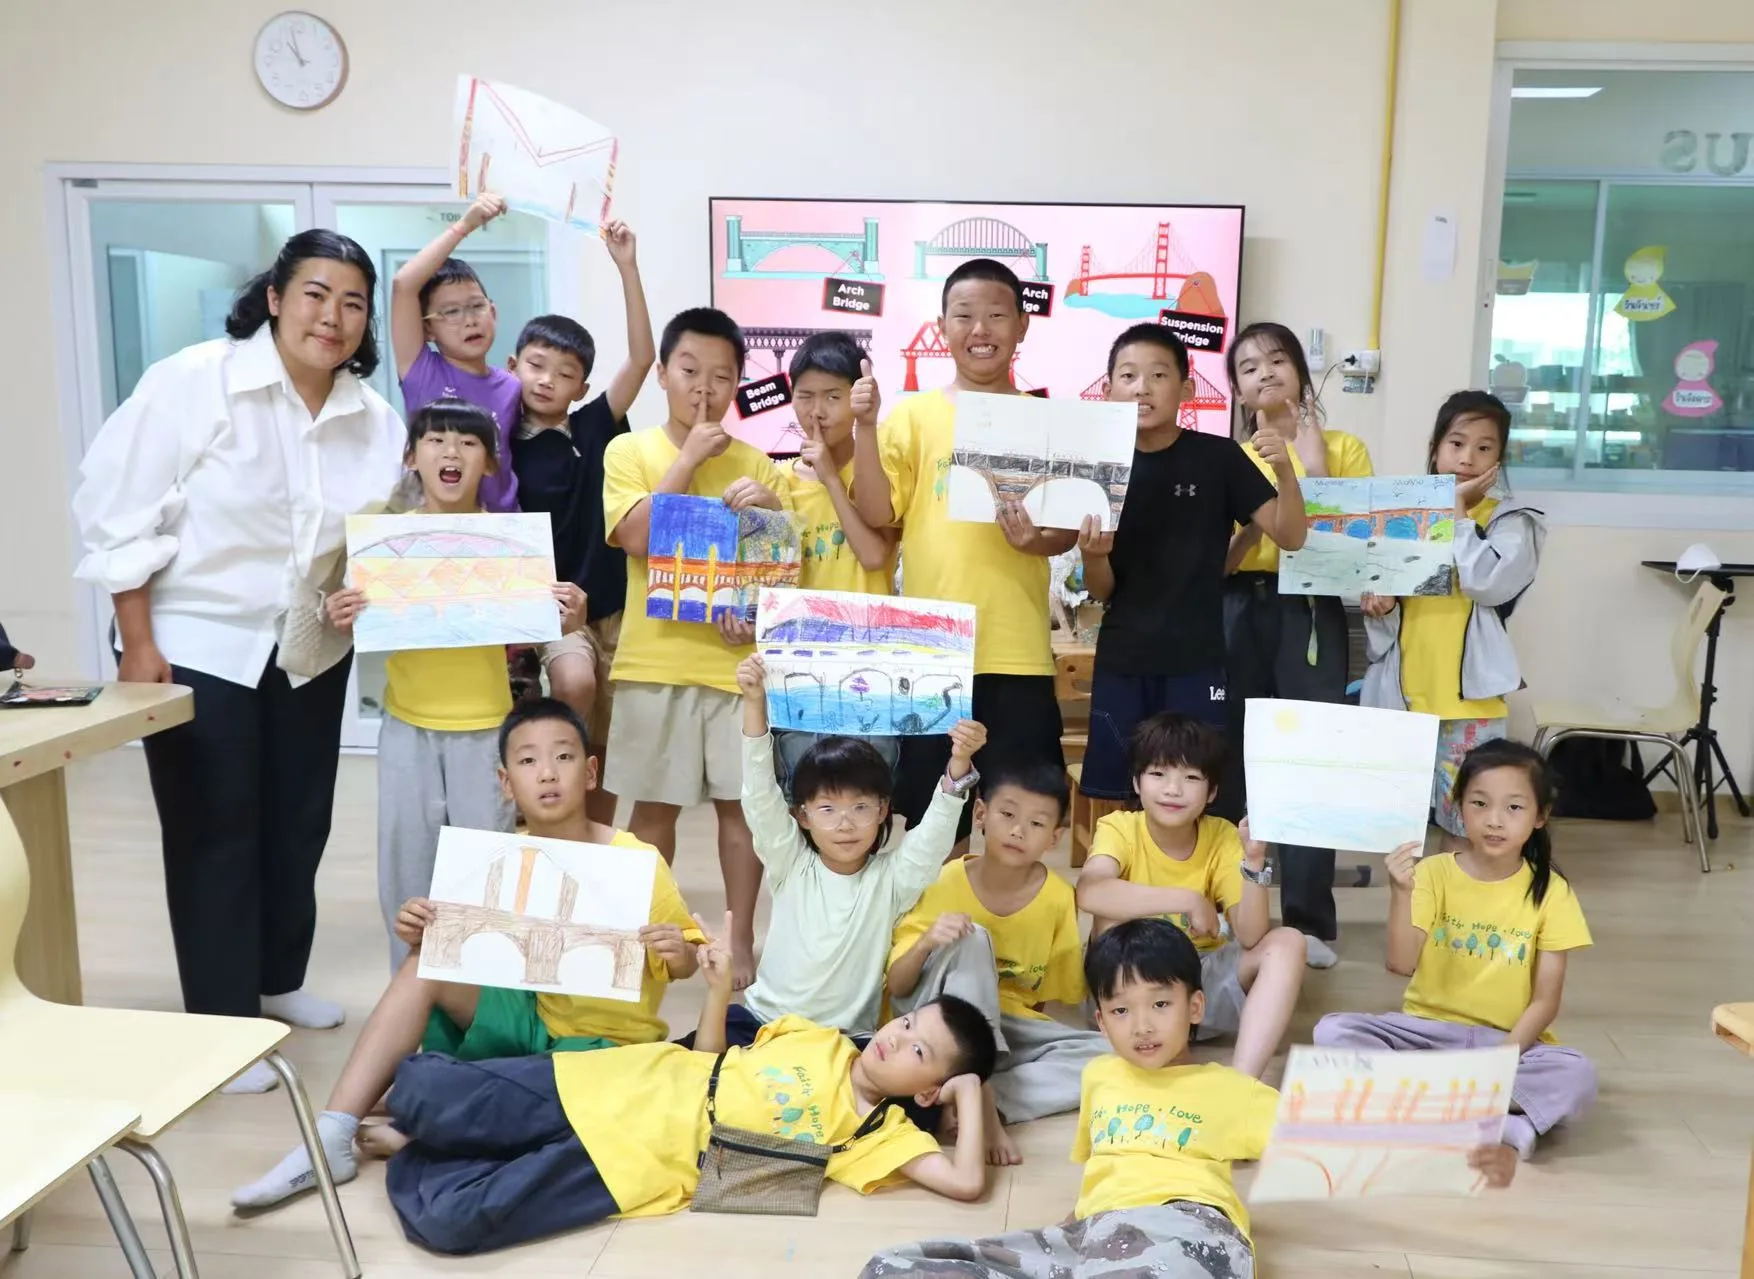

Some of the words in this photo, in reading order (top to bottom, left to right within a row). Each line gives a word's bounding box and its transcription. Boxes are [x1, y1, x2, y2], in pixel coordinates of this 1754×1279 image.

[838, 284, 864, 296] Arch
[1022, 287, 1048, 300] Arch
[833, 296, 870, 311] Bridge
[1161, 317, 1224, 334] Suspension
[746, 382, 776, 400] Beam
[750, 393, 785, 412] Bridge
[1116, 1103, 1150, 1114] Hope
[1169, 1105, 1203, 1124] Love
